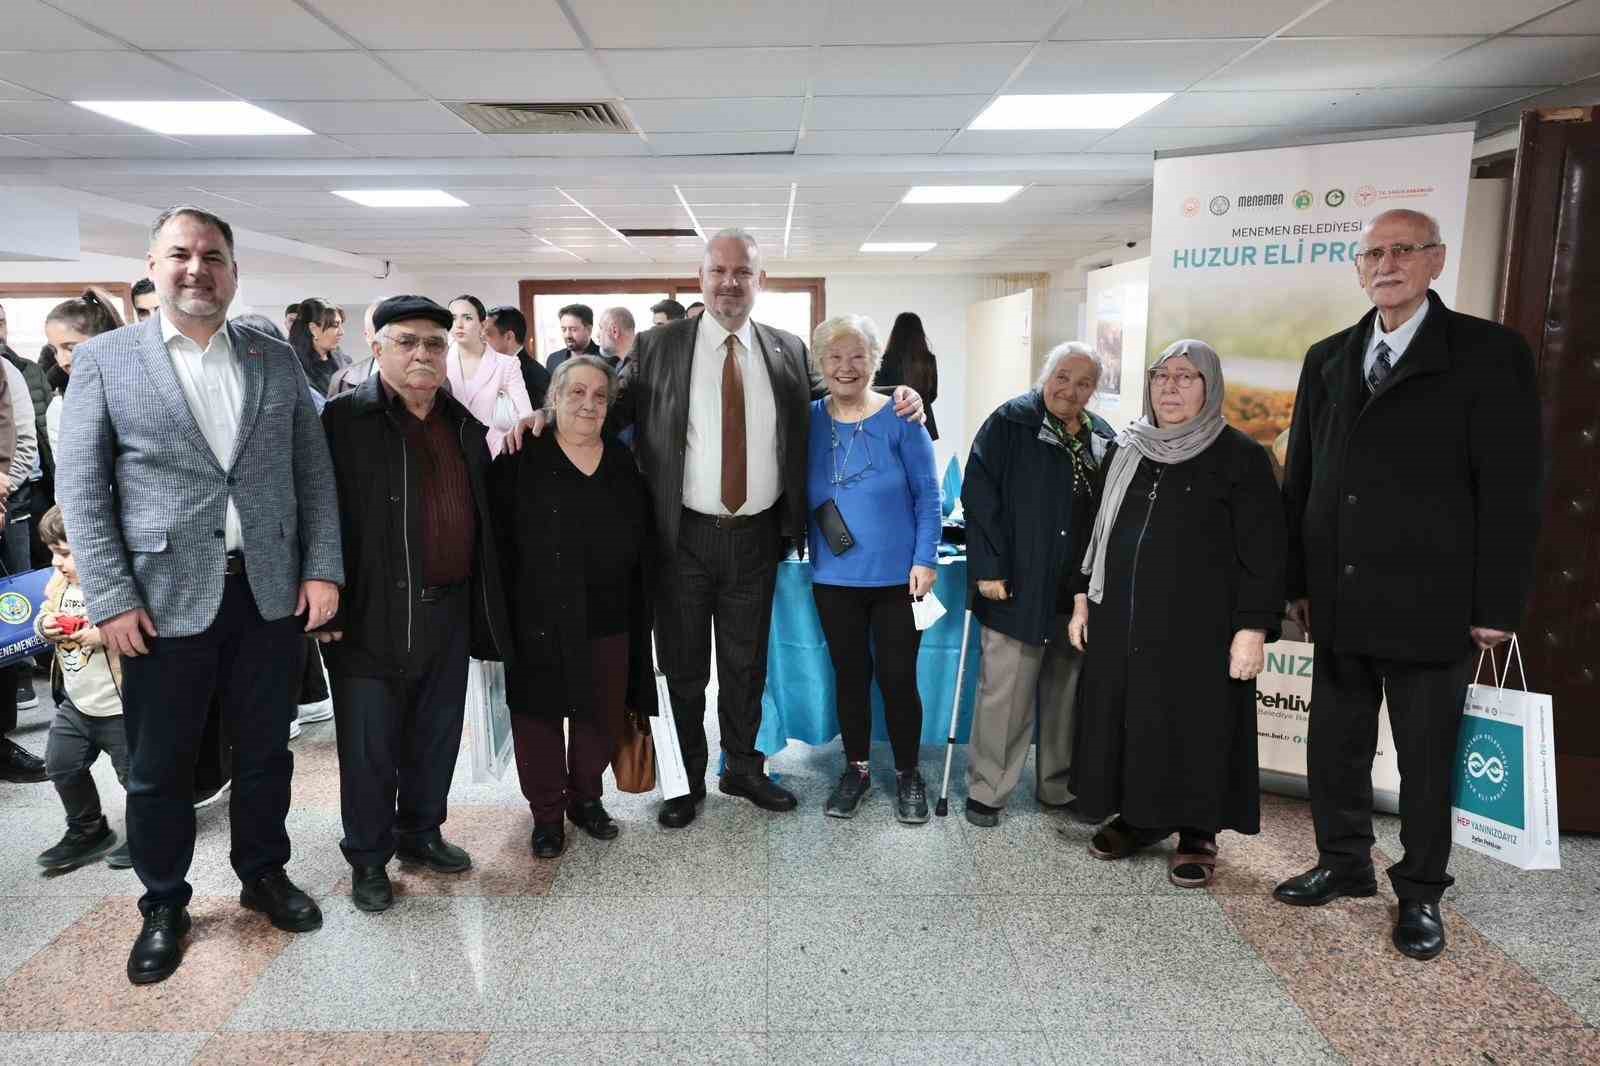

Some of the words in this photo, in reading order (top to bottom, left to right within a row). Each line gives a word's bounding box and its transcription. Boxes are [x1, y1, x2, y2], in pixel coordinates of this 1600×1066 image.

[1238, 194, 1284, 207] menemen
[1232, 226, 1290, 238] MENEMEN
[1173, 246, 1257, 269] HUZUR
[1264, 239, 1303, 265] ELİ
[1456, 816, 1471, 827] HEP
